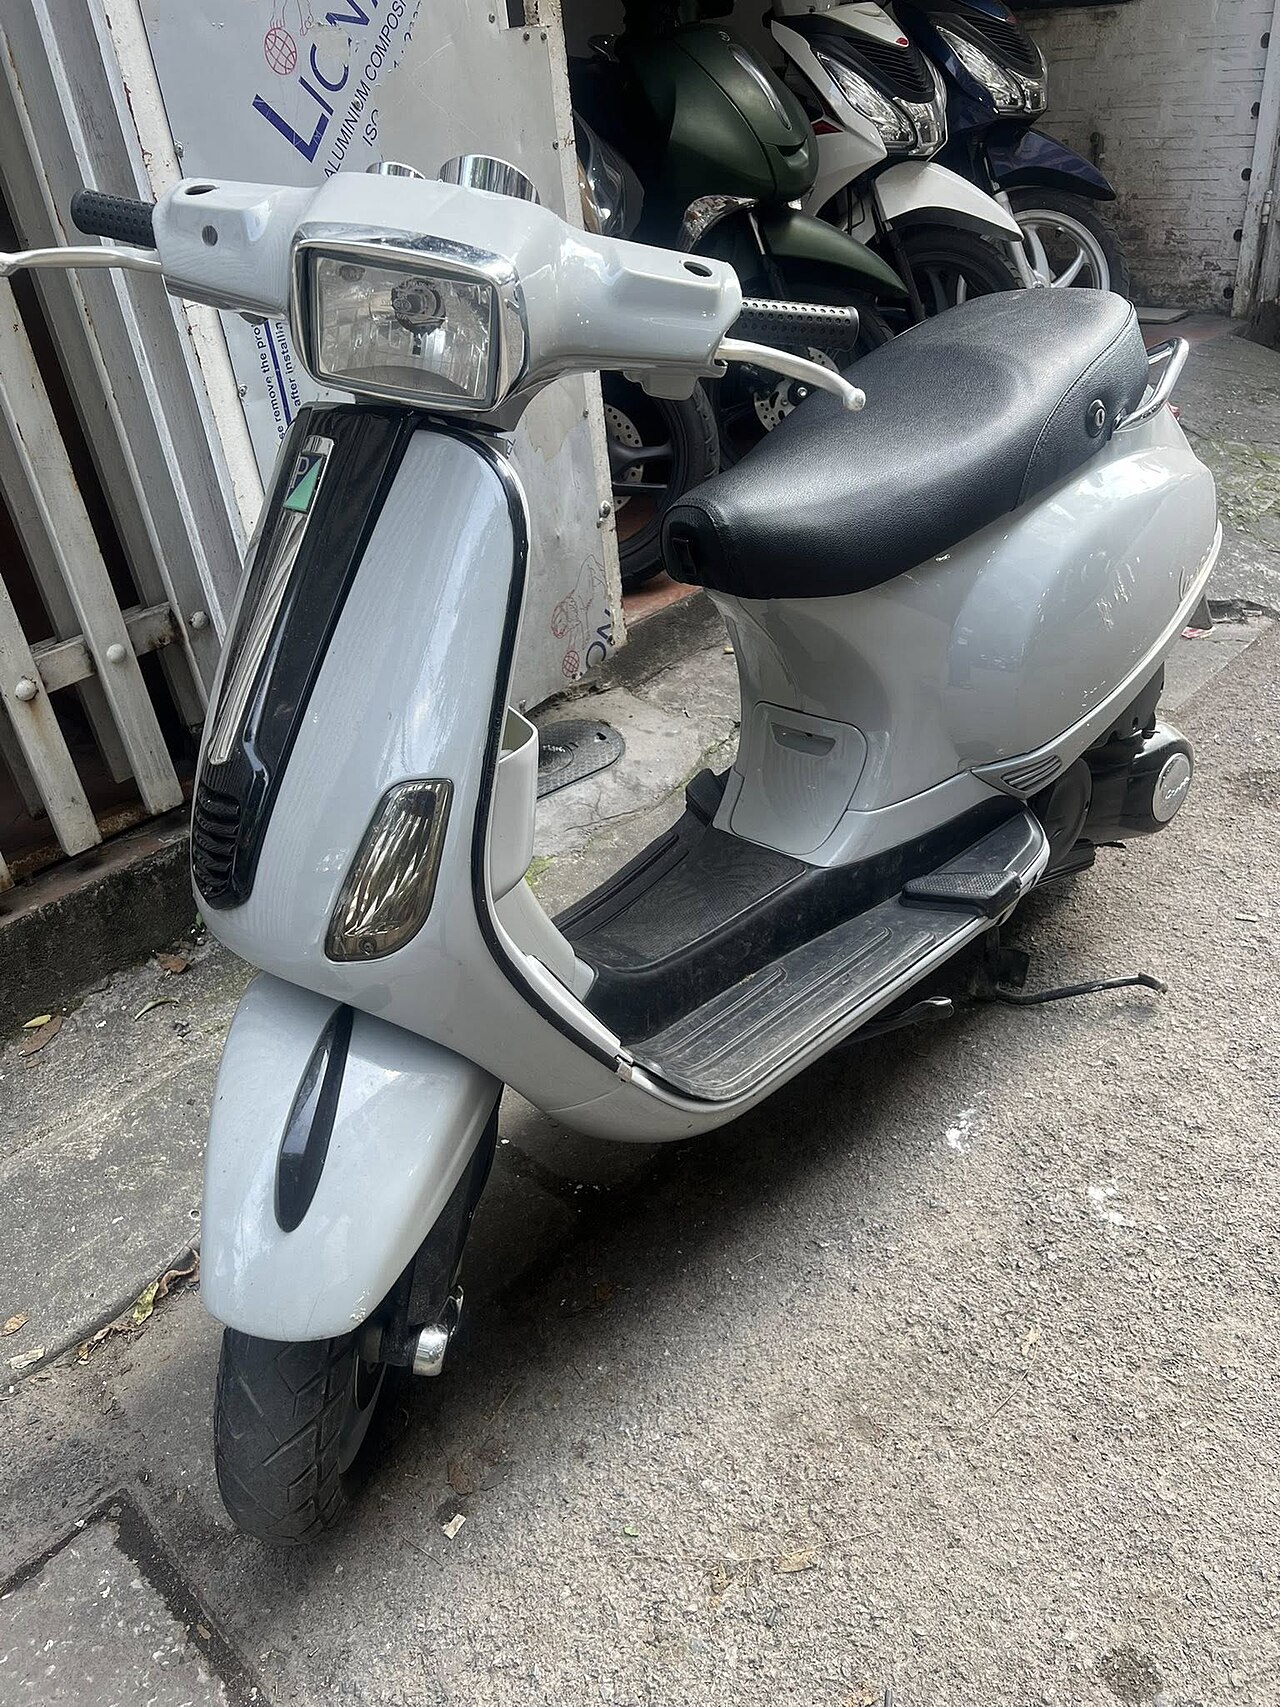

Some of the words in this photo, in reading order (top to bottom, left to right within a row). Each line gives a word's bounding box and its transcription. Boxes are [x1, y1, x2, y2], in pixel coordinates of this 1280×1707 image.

[323, 80, 371, 178] ALUMINIUM
[251, 324, 267, 350] pro
[260, 352, 270, 374] the
[289, 378, 301, 407] after
